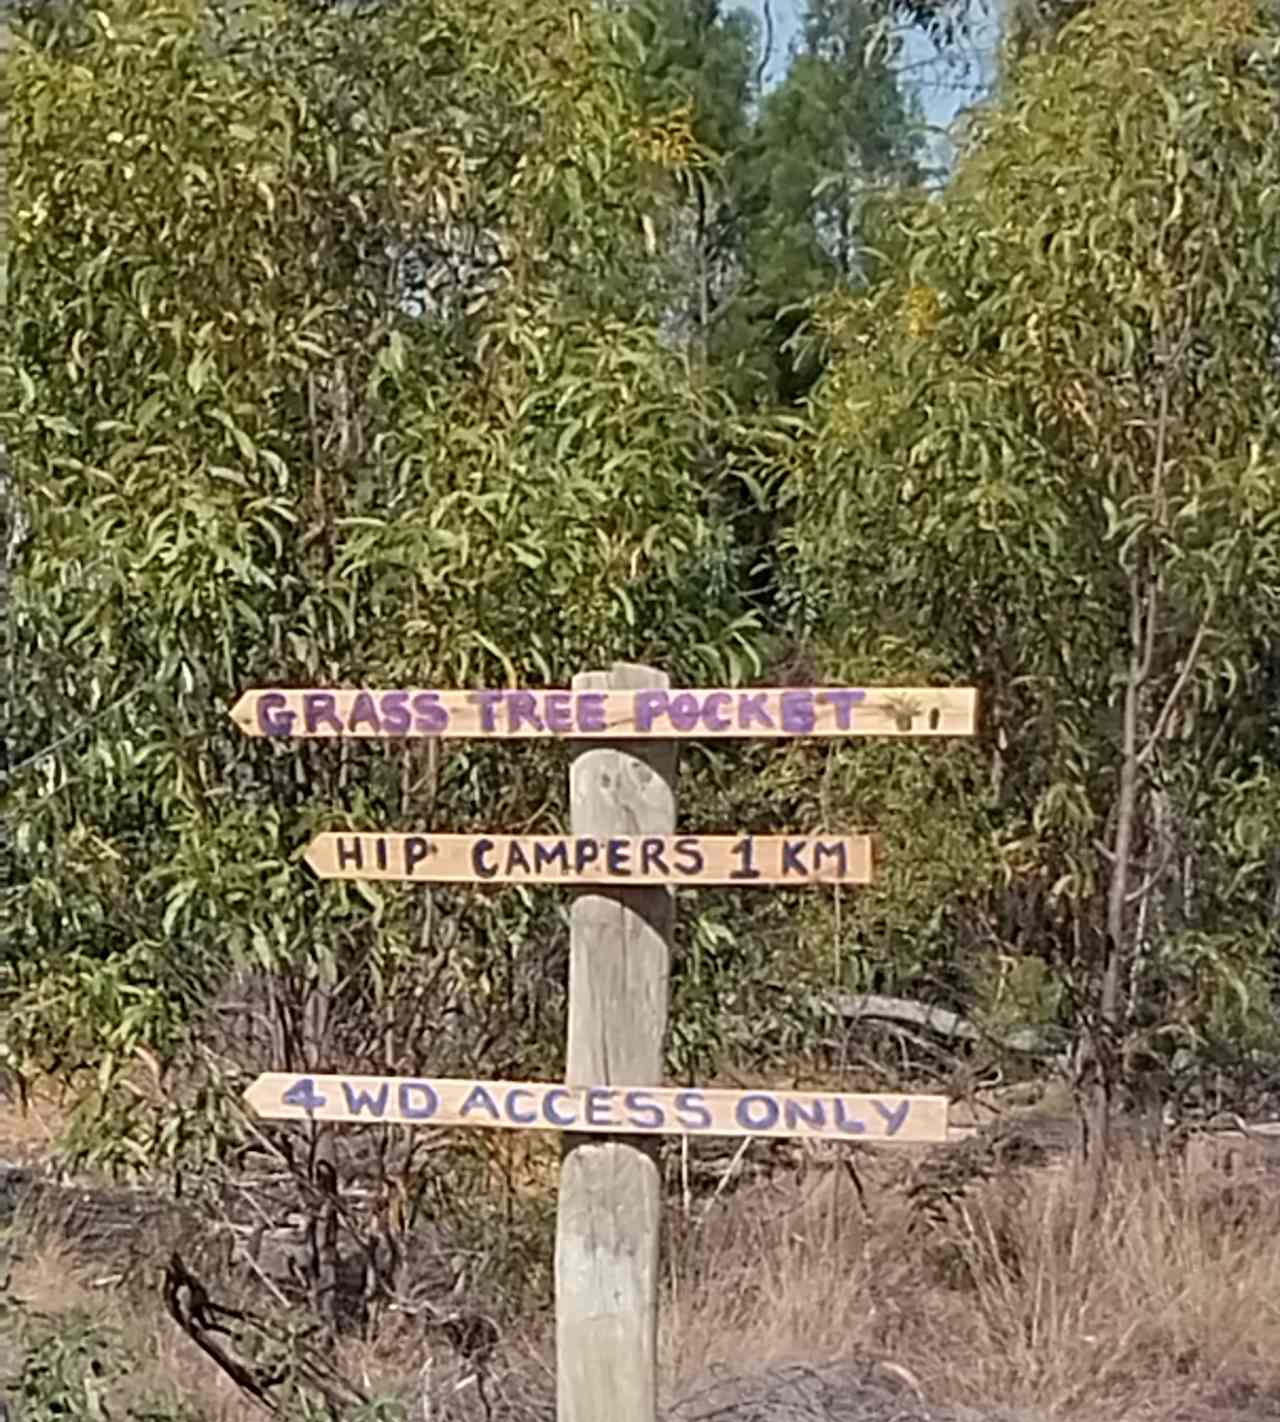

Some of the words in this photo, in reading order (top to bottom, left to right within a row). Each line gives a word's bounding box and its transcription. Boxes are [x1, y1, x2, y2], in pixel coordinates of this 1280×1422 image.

[256, 691, 449, 737] GRASS
[465, 690, 609, 733] TREE
[634, 689, 866, 734] POCKET
[336, 836, 429, 876] HIP
[471, 837, 703, 879] CAMPERS
[729, 836, 760, 879] 1
[781, 839, 848, 878] KM
[458, 1084, 713, 1130] ACCESS
[735, 1093, 910, 1136] ONLY
